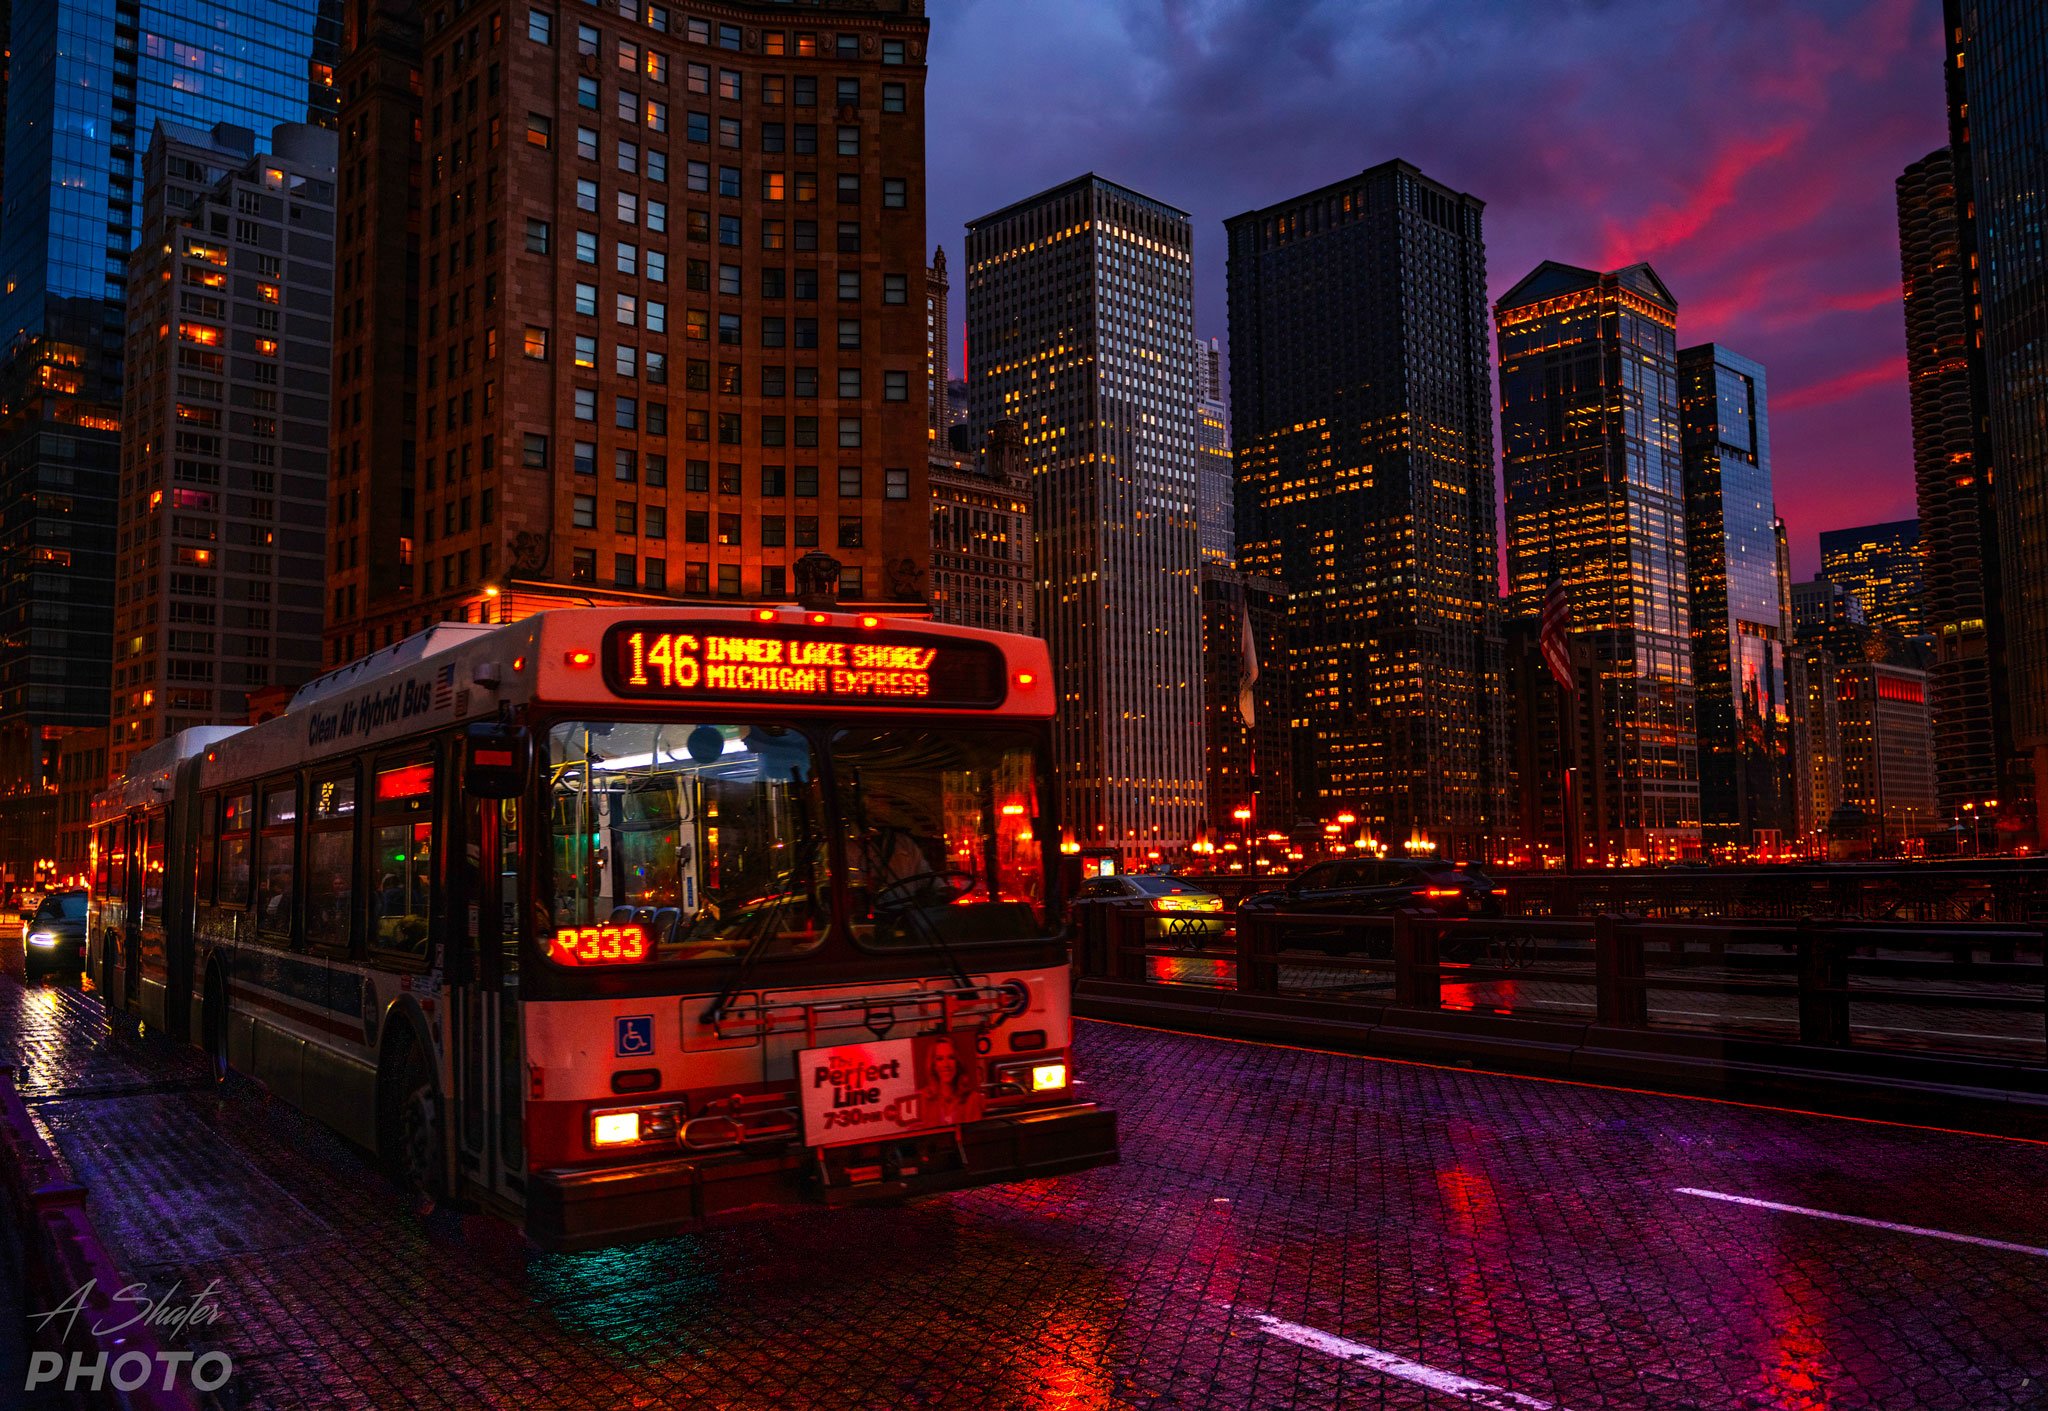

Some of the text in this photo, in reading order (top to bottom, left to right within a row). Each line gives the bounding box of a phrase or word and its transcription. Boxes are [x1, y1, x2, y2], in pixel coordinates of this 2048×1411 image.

[626, 631, 700, 688] 146
[706, 635, 785, 663] INNER
[789, 640, 848, 666] LAKE
[705, 665, 930, 696] MICHIGAN EXPRESS
[308, 712, 338, 746] Clean
[339, 702, 357, 738] Air
[358, 683, 403, 737] Hybrid
[402, 679, 432, 718] Bus
[813, 1059, 900, 1088] Perfect
[833, 1085, 881, 1108] Line
